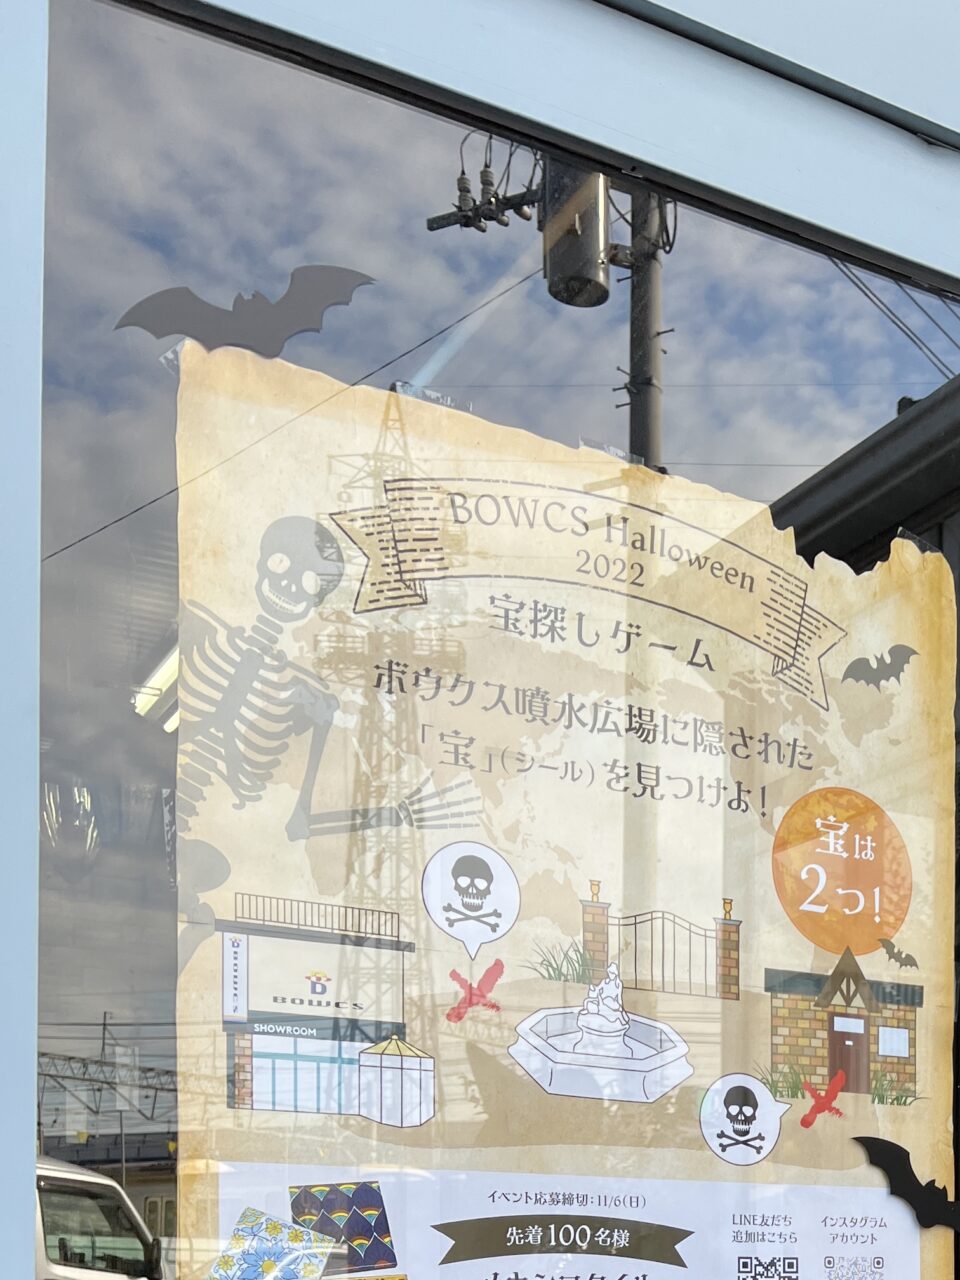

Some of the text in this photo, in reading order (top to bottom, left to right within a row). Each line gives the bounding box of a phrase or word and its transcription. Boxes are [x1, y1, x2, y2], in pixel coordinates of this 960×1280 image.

[447, 492, 756, 593] BOWCS Halloween
[575, 549, 646, 587] 2022
[488, 593, 716, 673] 宝探しゲーム
[373, 658, 815, 772] ボウクス噴水広場に隠された
[815, 815, 876, 861] 宝は
[799, 863, 881, 924] 2つ！
[254, 1023, 317, 1037] SHOWROOM
[506, 1223, 631, 1248] 先着100名様
[732, 1214, 793, 1227] LINE友だち
[820, 1216, 888, 1229] インスタグラム
[731, 1230, 798, 1244] 追加はこちら
[829, 1233, 878, 1245] アカウント
